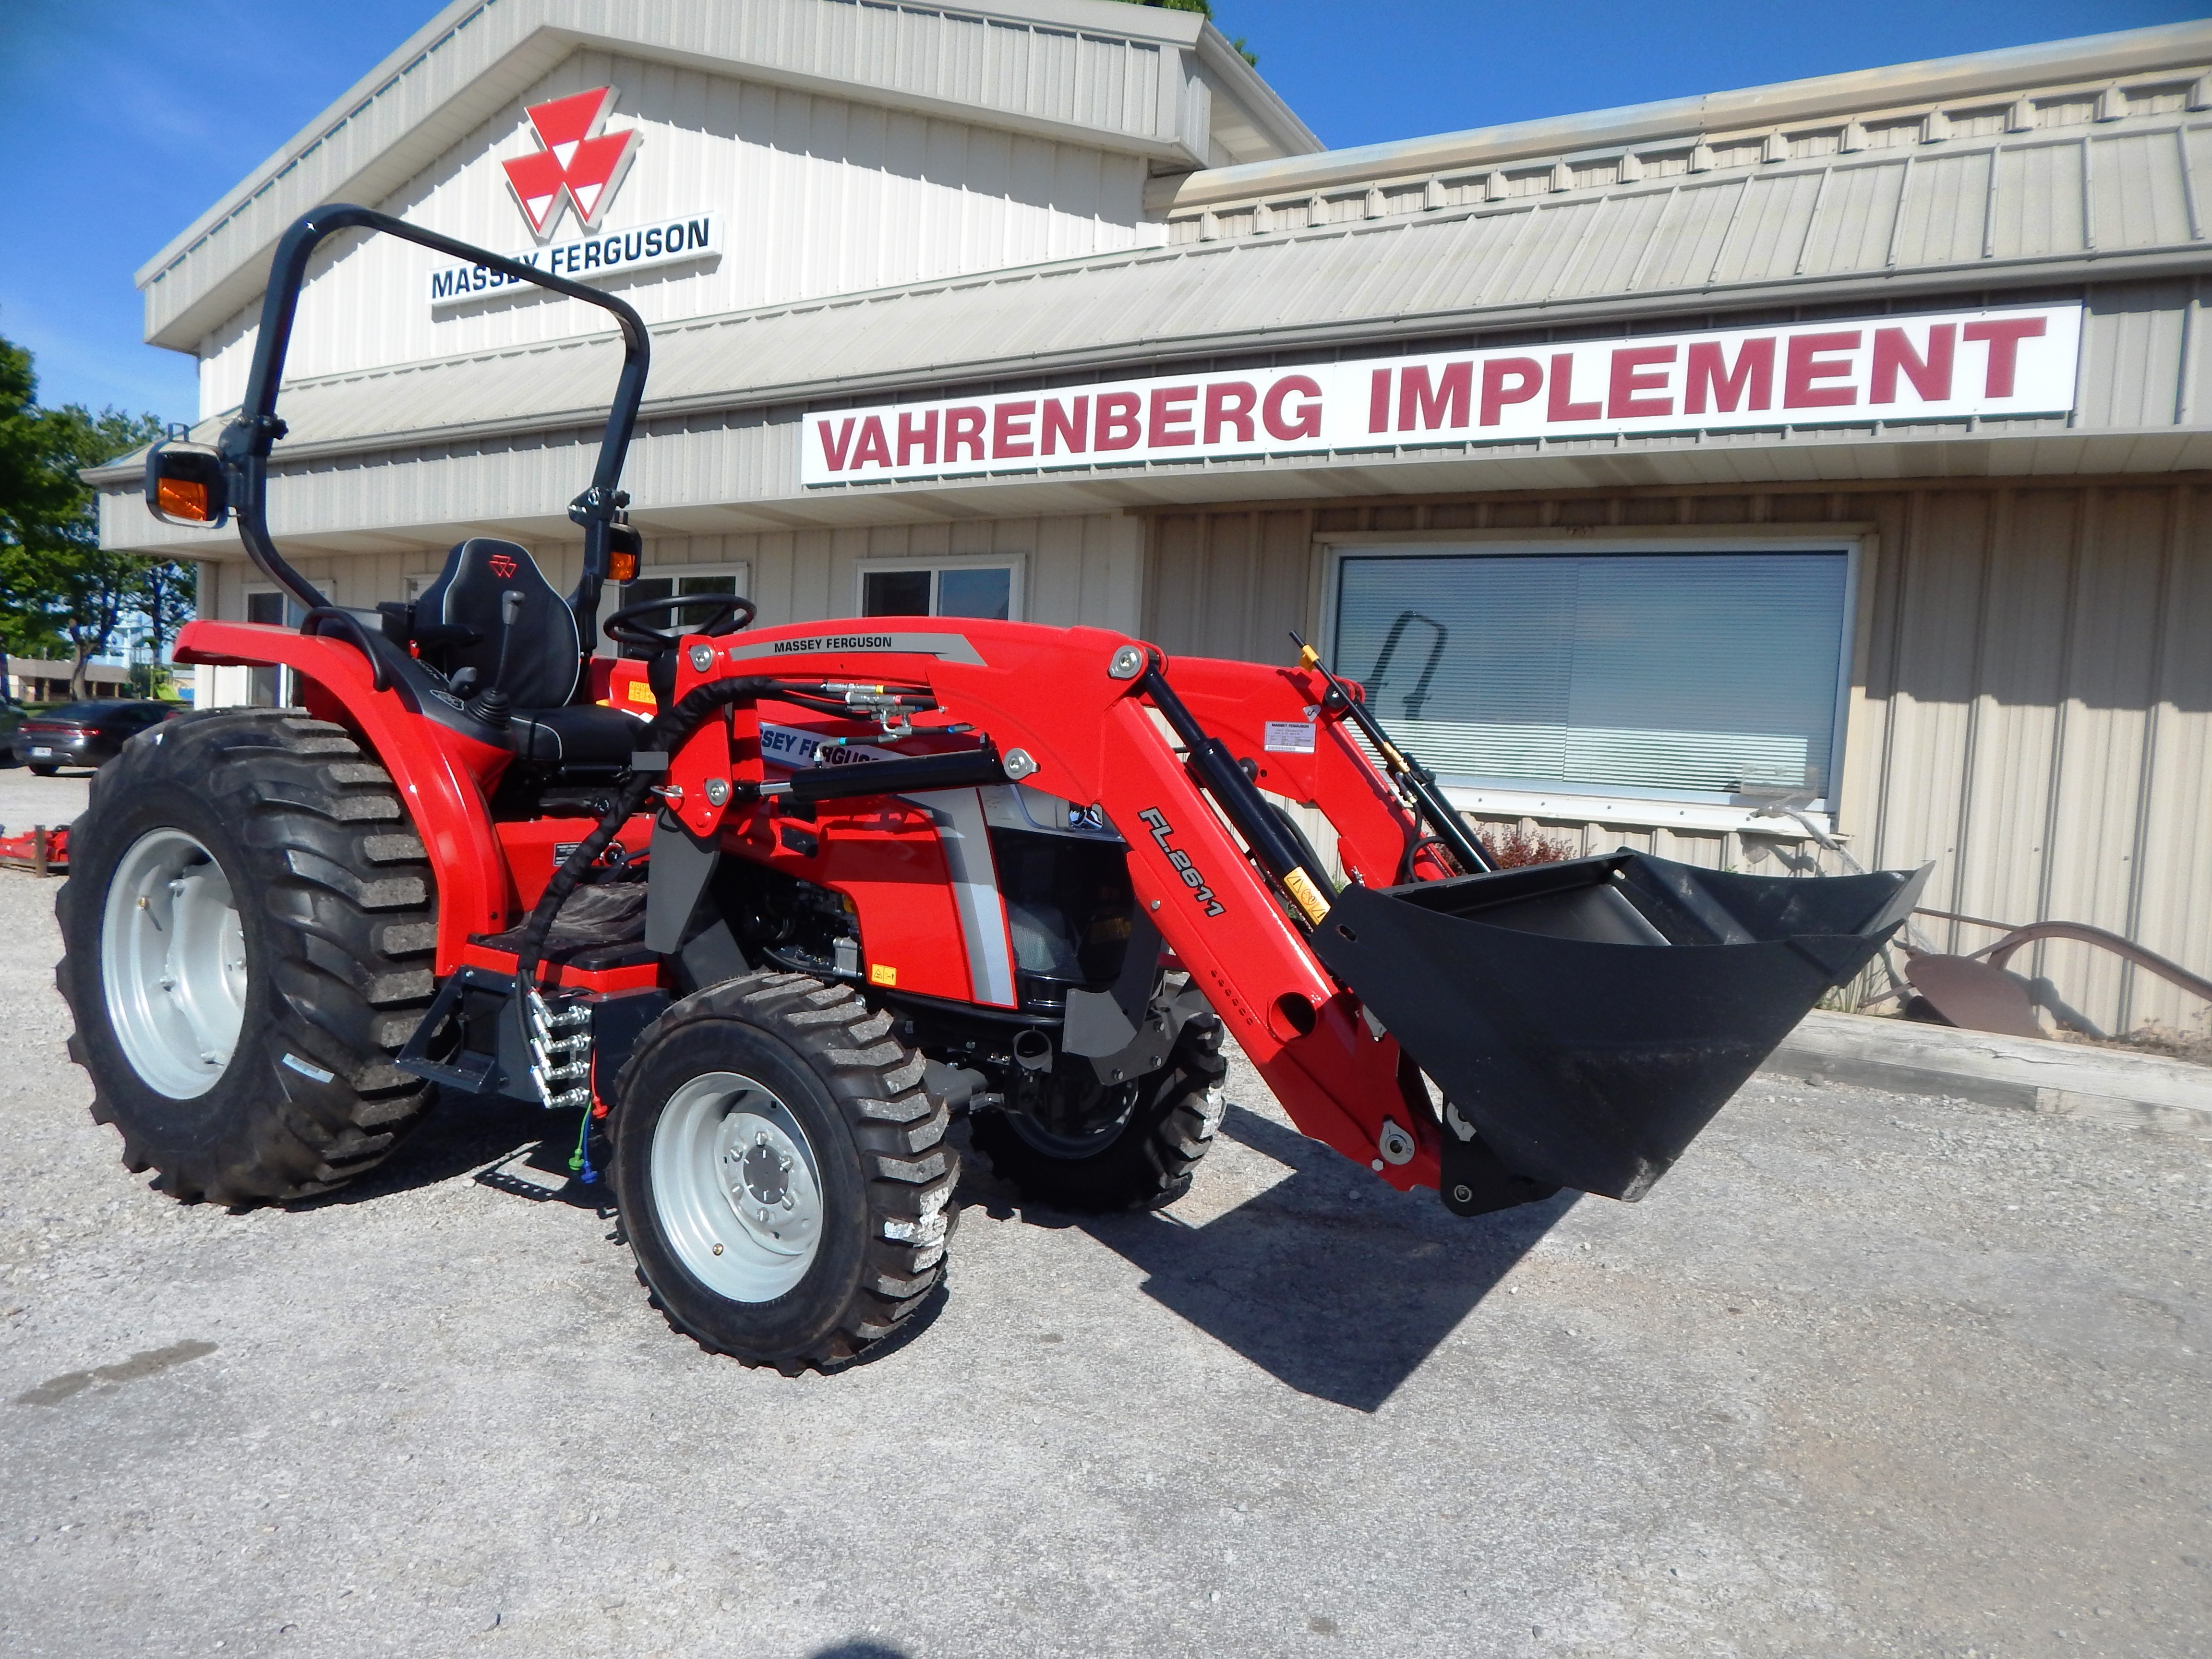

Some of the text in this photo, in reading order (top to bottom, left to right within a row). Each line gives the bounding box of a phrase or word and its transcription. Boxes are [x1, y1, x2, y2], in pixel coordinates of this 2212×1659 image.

[551, 217, 709, 274] FERGUSON
[817, 315, 2048, 472] VAHRENBERG IMPLEMENT
[774, 637, 892, 653] MASSEY FERGUSON
